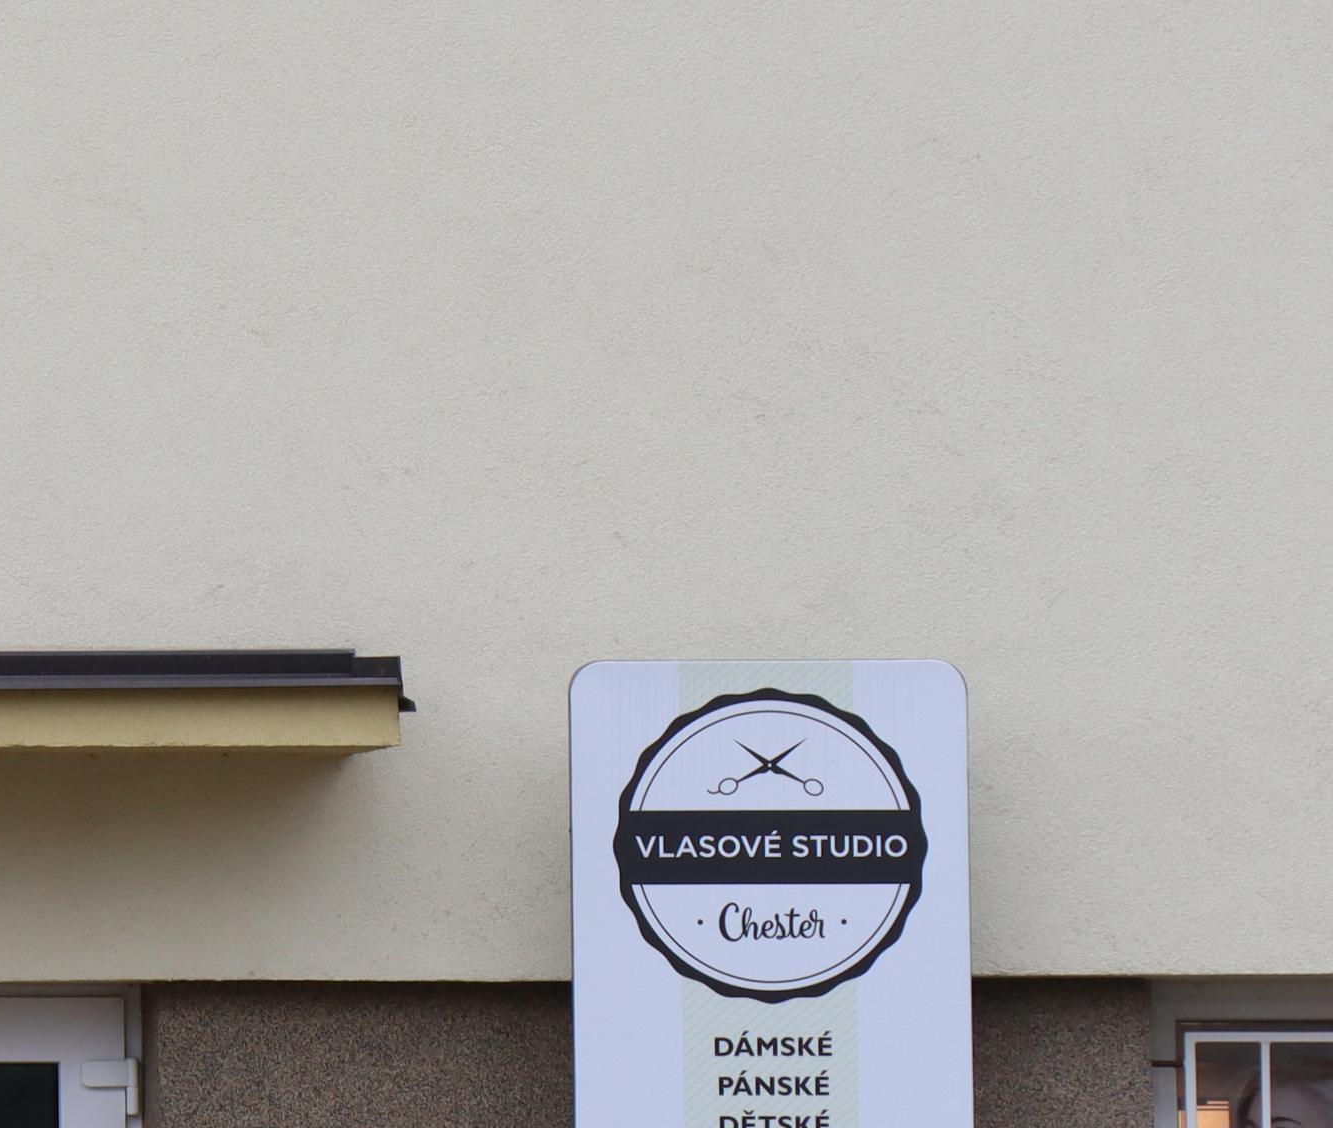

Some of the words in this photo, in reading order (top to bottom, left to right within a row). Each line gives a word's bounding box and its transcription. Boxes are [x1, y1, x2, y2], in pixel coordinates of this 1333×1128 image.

[635, 829, 782, 858] VLASOVÉ
[792, 834, 908, 858] STUDIO
[718, 902, 825, 942] Chester
[714, 1030, 833, 1057] DÁMSKÉ
[718, 1069, 830, 1096] PÁNSKÉ
